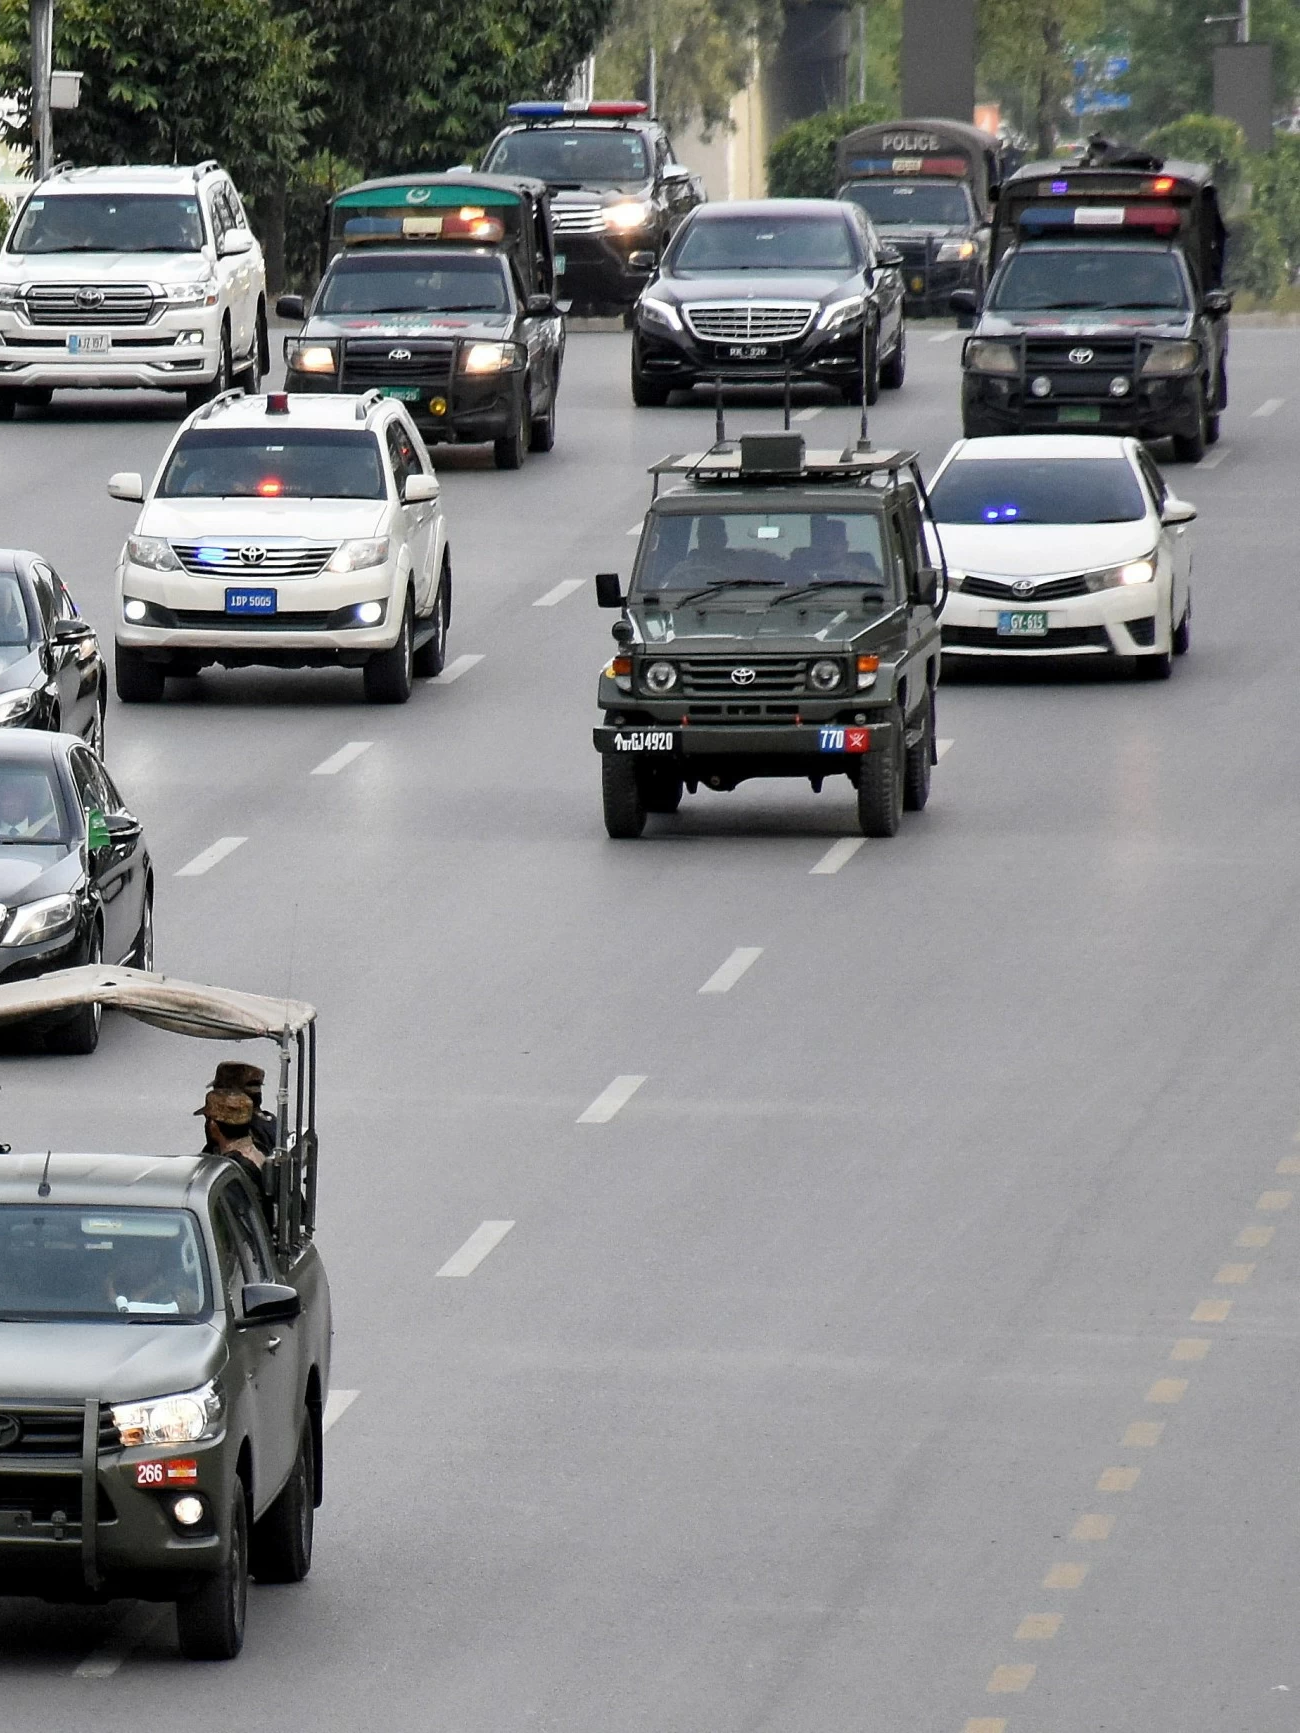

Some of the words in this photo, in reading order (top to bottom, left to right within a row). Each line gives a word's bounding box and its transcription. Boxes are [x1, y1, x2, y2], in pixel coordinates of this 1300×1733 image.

[882, 134, 939, 151] POLICE
[820, 730, 845, 749] 770
[137, 1463, 163, 1484] 266
